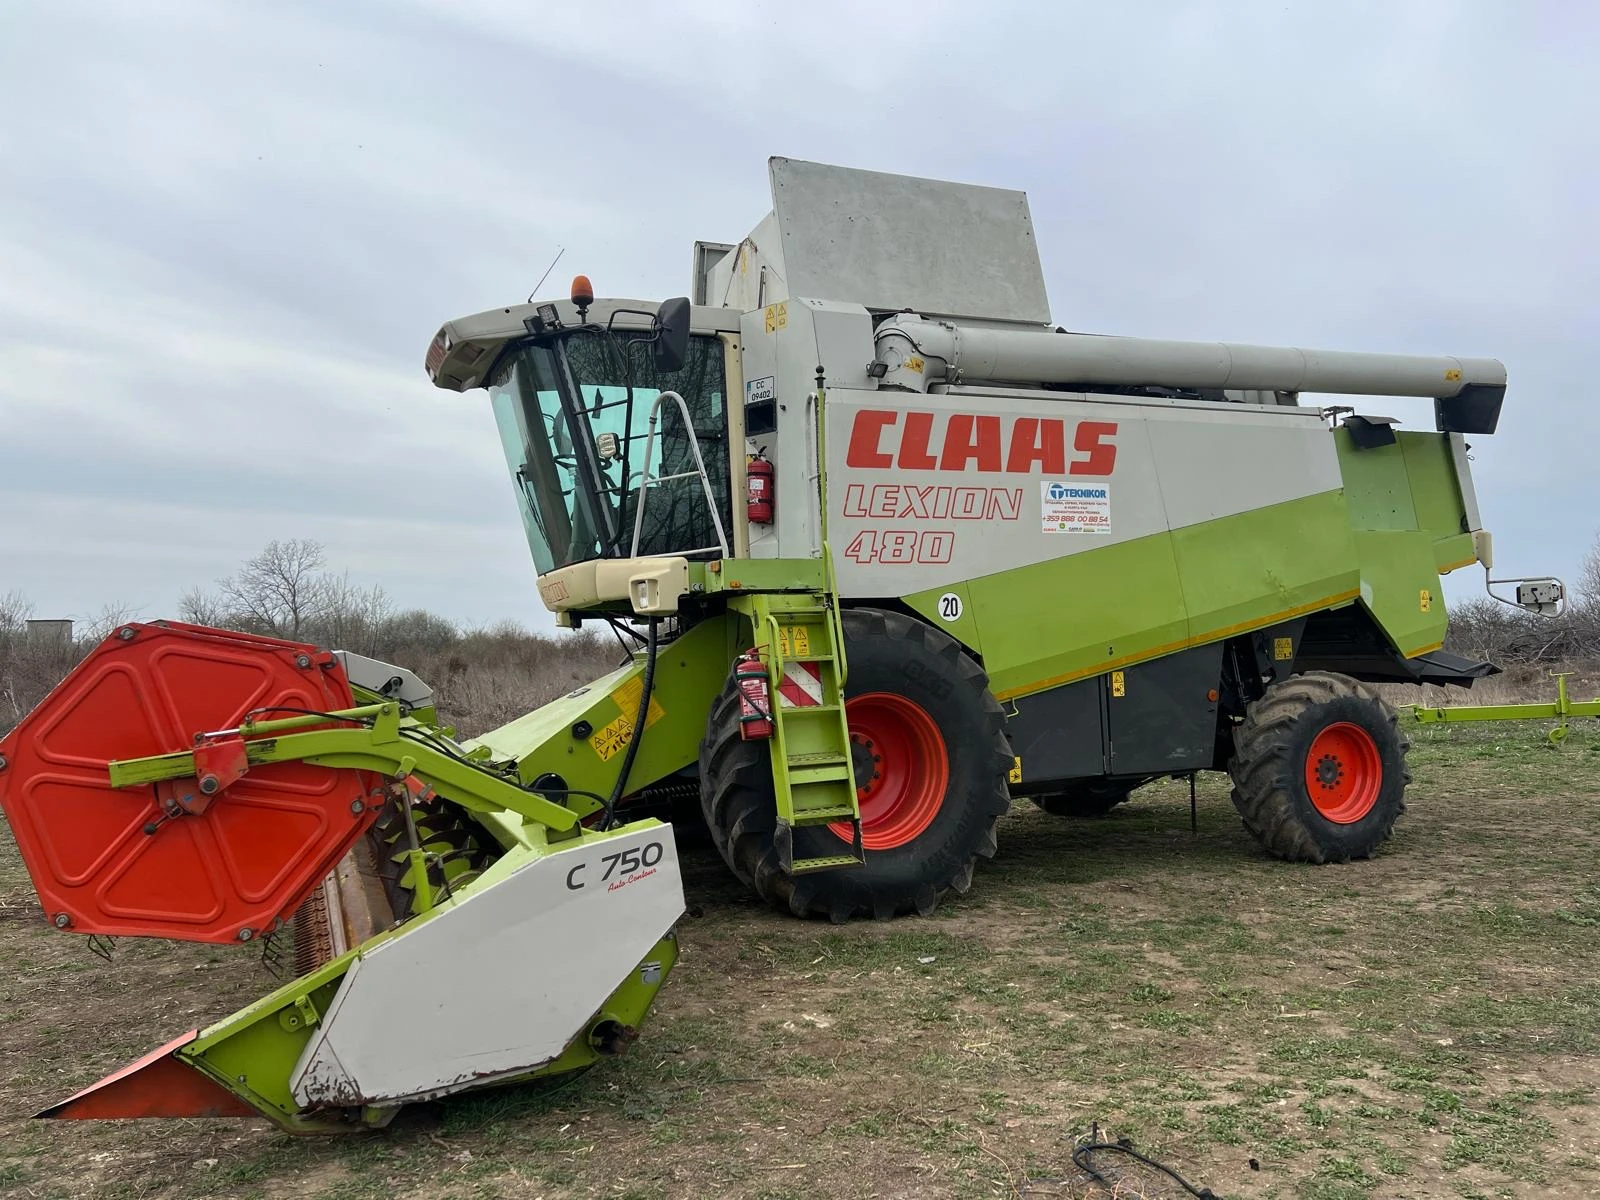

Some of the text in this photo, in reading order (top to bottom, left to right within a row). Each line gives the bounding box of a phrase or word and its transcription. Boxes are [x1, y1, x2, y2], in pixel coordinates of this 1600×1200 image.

[751, 390, 771, 401] 09402
[756, 381, 765, 389] CC
[846, 409, 1119, 476] CLAAS
[843, 483, 1023, 520] LEXION
[1064, 488, 1106, 498] TEKNIKOR
[844, 530, 955, 564] 480
[942, 597, 959, 618] 20
[566, 842, 664, 890] C 750
[607, 868, 657, 893] Auto-Contour
